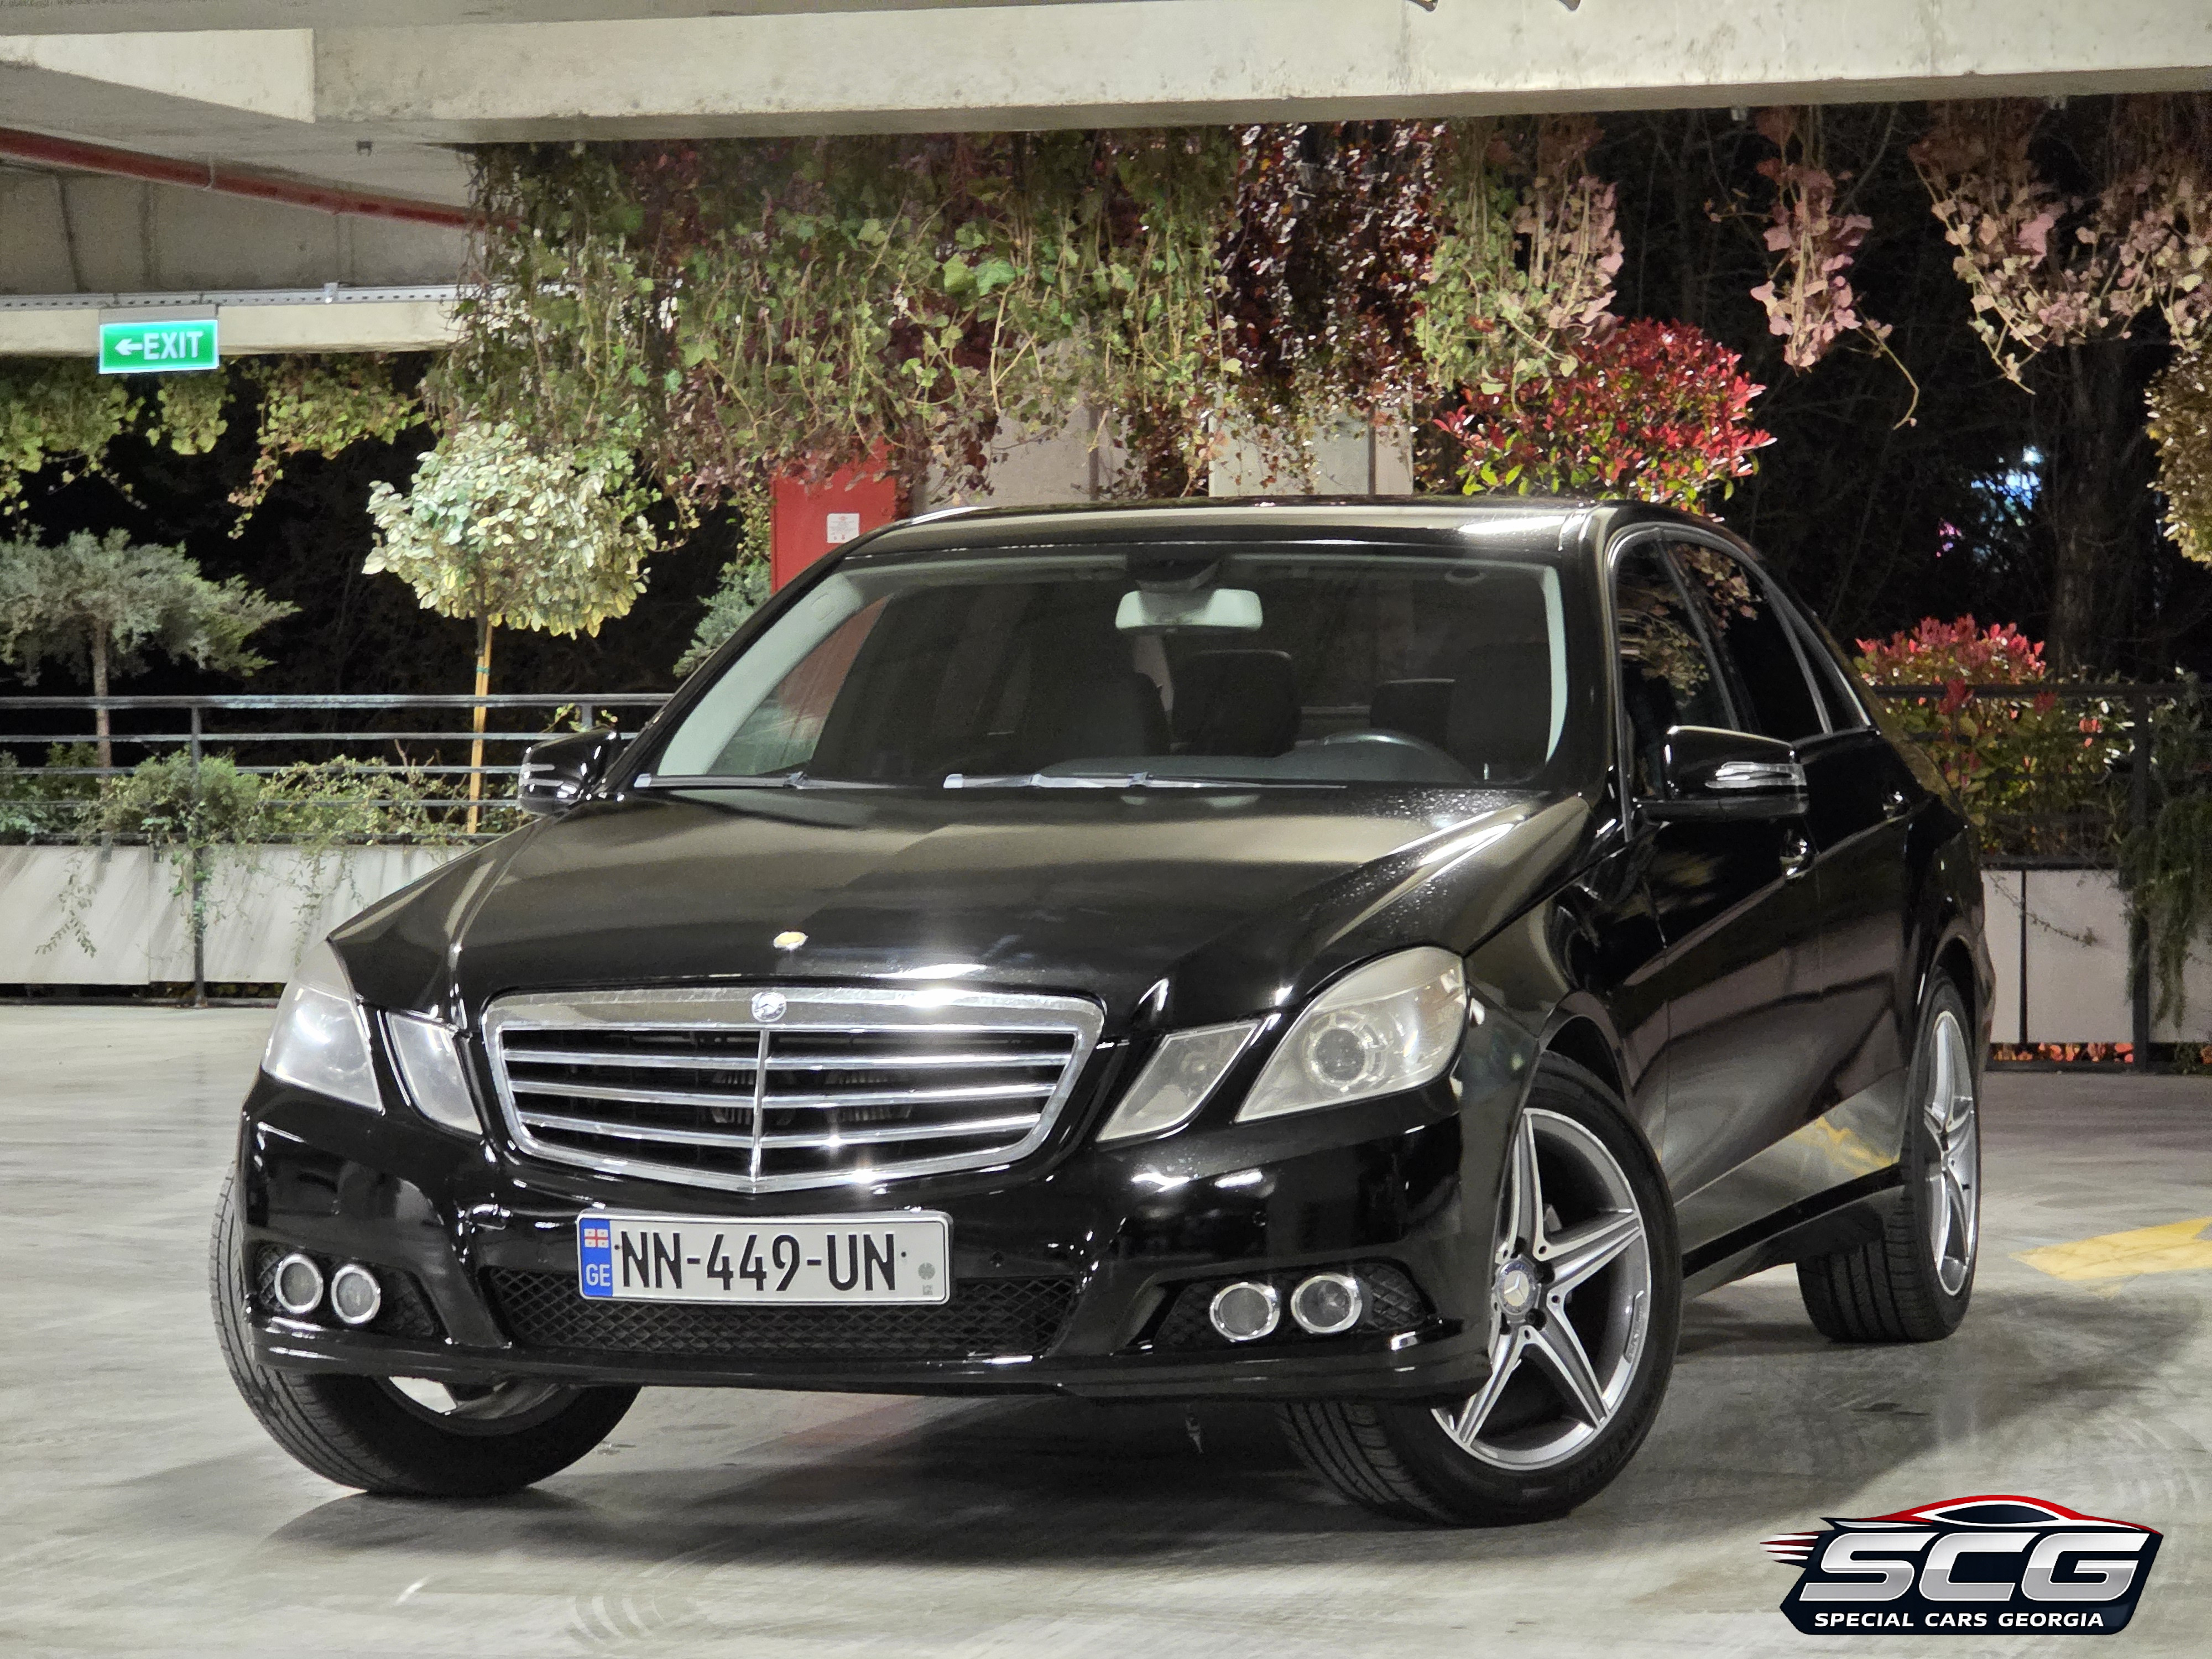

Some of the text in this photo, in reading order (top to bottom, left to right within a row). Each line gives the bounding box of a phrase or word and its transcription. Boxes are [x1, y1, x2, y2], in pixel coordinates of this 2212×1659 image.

[143, 330, 204, 361] EXIT
[585, 1263, 611, 1287] GE
[620, 1230, 896, 1292] NN-449-UN
